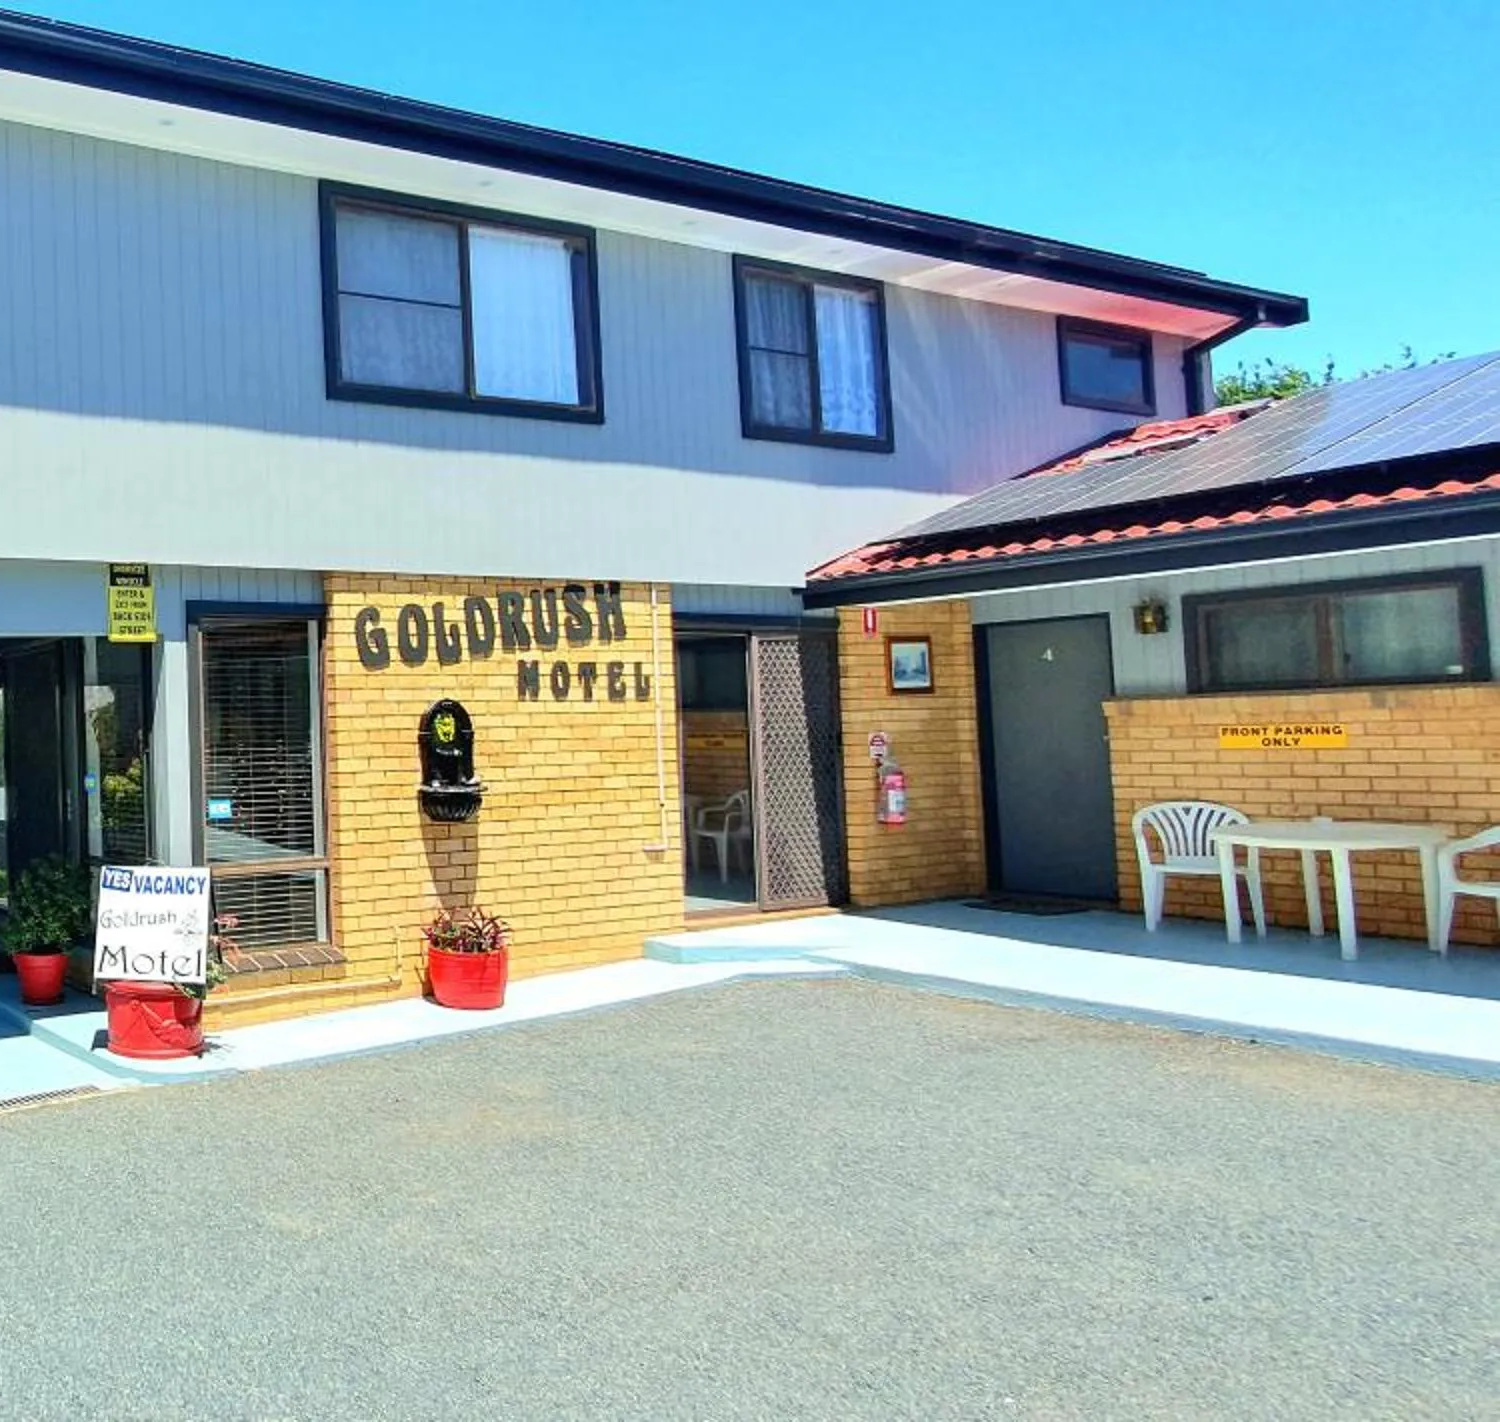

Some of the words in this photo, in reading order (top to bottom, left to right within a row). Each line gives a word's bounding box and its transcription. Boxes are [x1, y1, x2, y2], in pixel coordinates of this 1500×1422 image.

[355, 580, 627, 671] GOLDRUSH
[1041, 647, 1053, 661] 4
[516, 659, 650, 701] MOTEL
[1220, 727, 1268, 736] FRONT
[1274, 725, 1343, 736] PARKING
[1261, 737, 1301, 747] ONLY
[104, 868, 132, 889] YES
[134, 874, 206, 895] VACANCY
[99, 908, 177, 929] Goldrush
[98, 944, 202, 977] Motel
